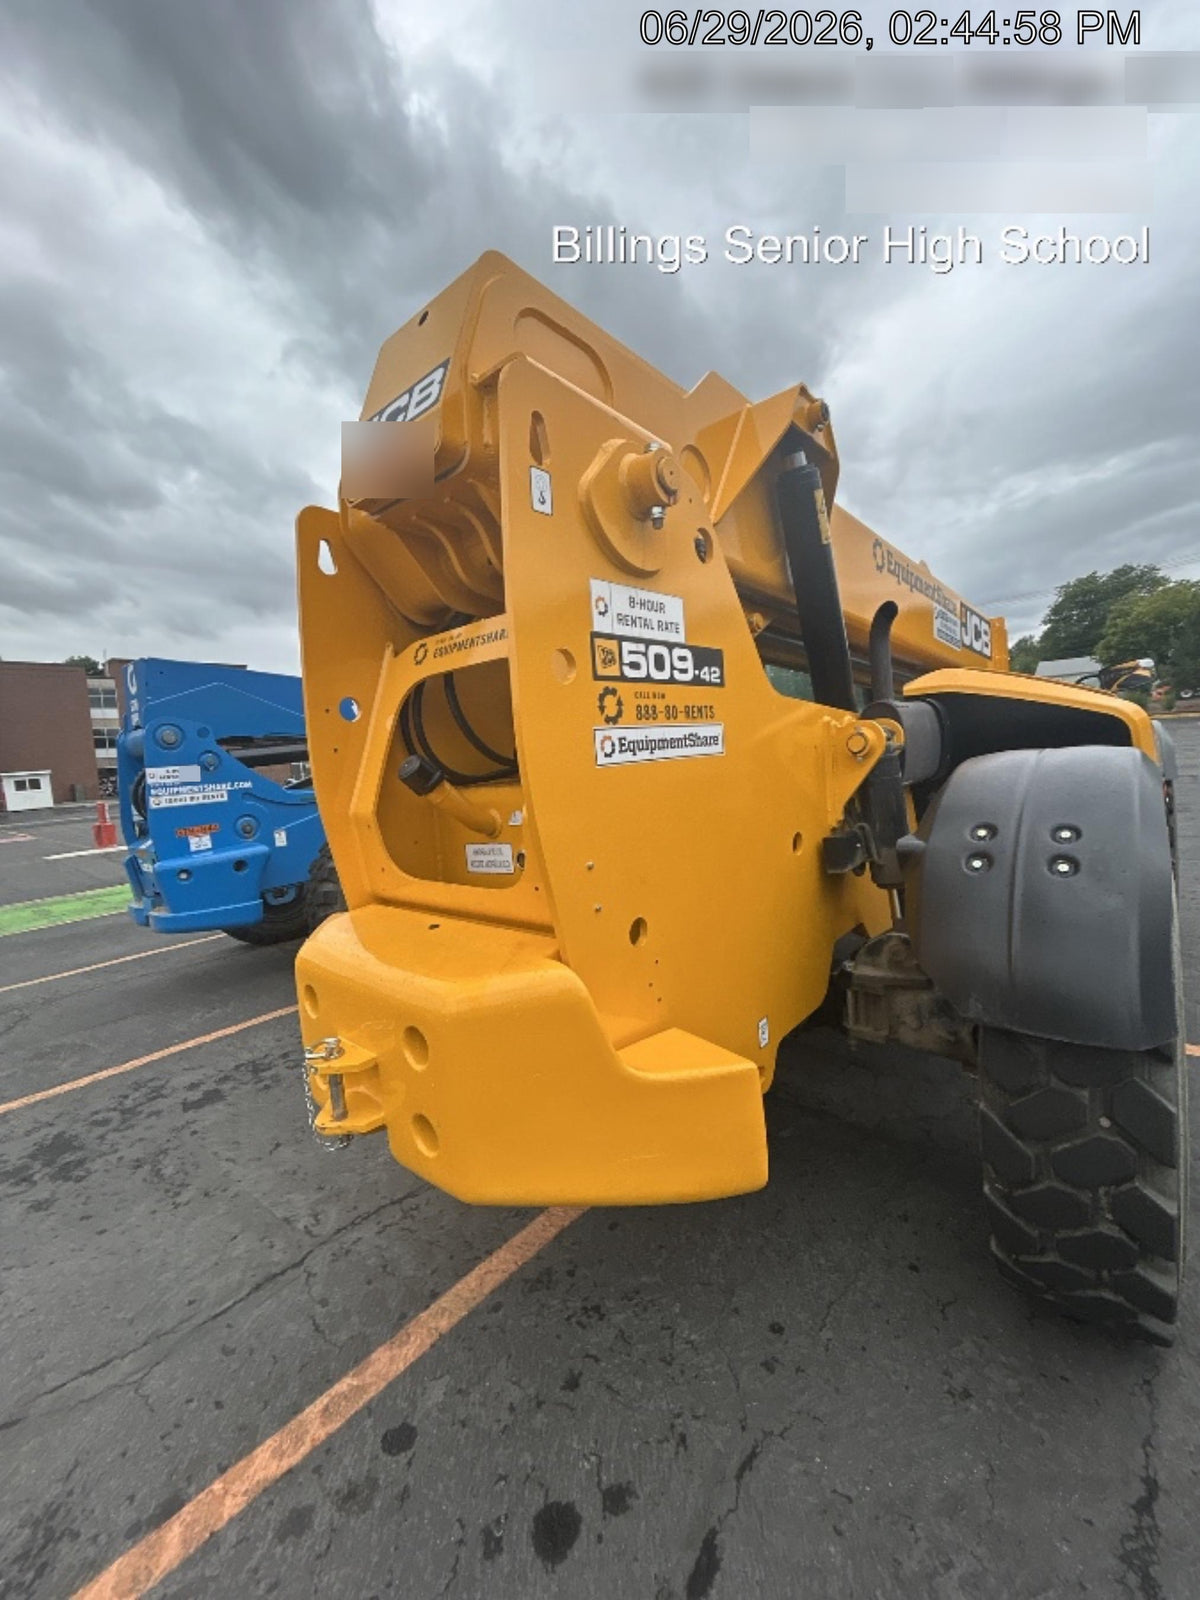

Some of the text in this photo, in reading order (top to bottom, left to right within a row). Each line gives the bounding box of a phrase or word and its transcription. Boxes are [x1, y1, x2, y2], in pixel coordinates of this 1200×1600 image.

[371, 367, 446, 422] CB
[628, 596, 666, 614] 8-HOUR
[616, 613, 680, 634] RENTAL RATE
[961, 607, 991, 657] JCB
[618, 732, 720, 756] EquipmentShare
